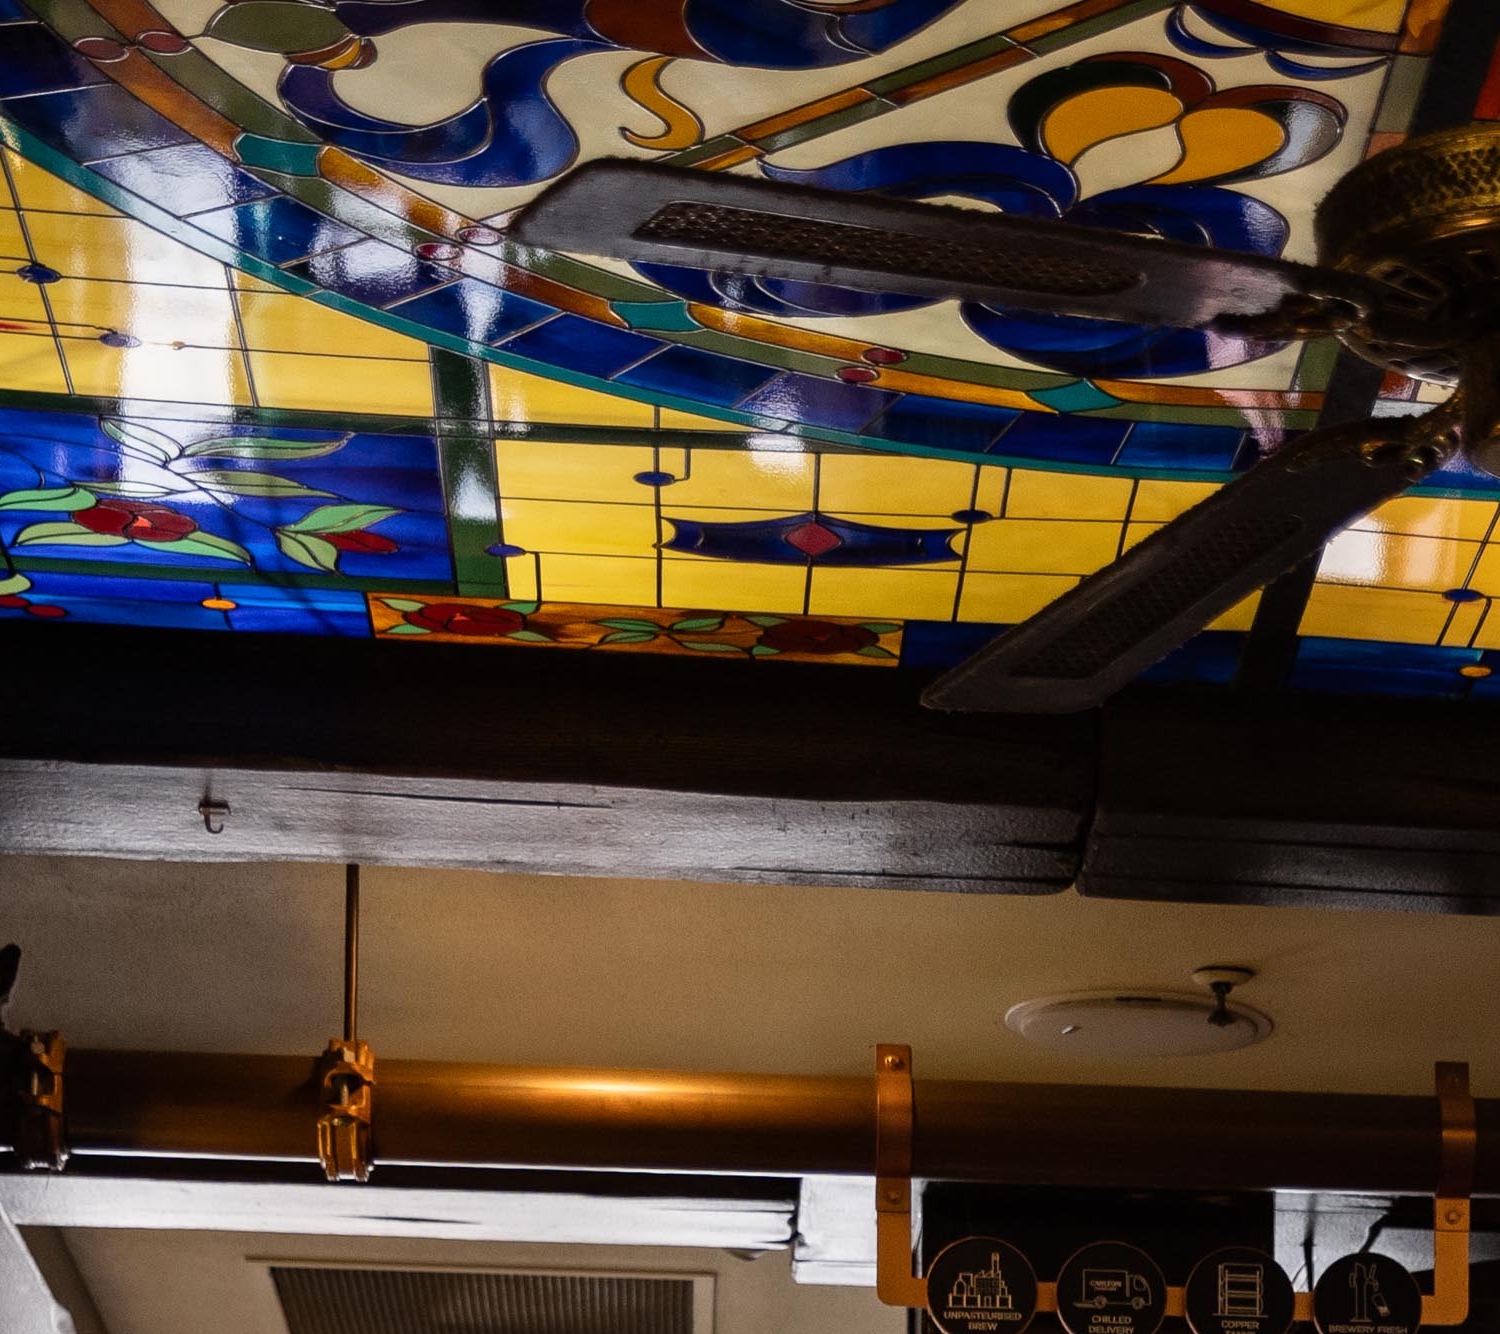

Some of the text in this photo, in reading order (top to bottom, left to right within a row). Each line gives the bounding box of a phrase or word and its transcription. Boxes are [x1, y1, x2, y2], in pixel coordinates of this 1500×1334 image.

[942, 1311, 1023, 1322] UNPASTEURISED
[1091, 1314, 1133, 1325] CHILLED
[967, 1321, 999, 1332] BREW
[1220, 1319, 1260, 1331] COPPER
[1328, 1323, 1375, 1334] BREWERY
